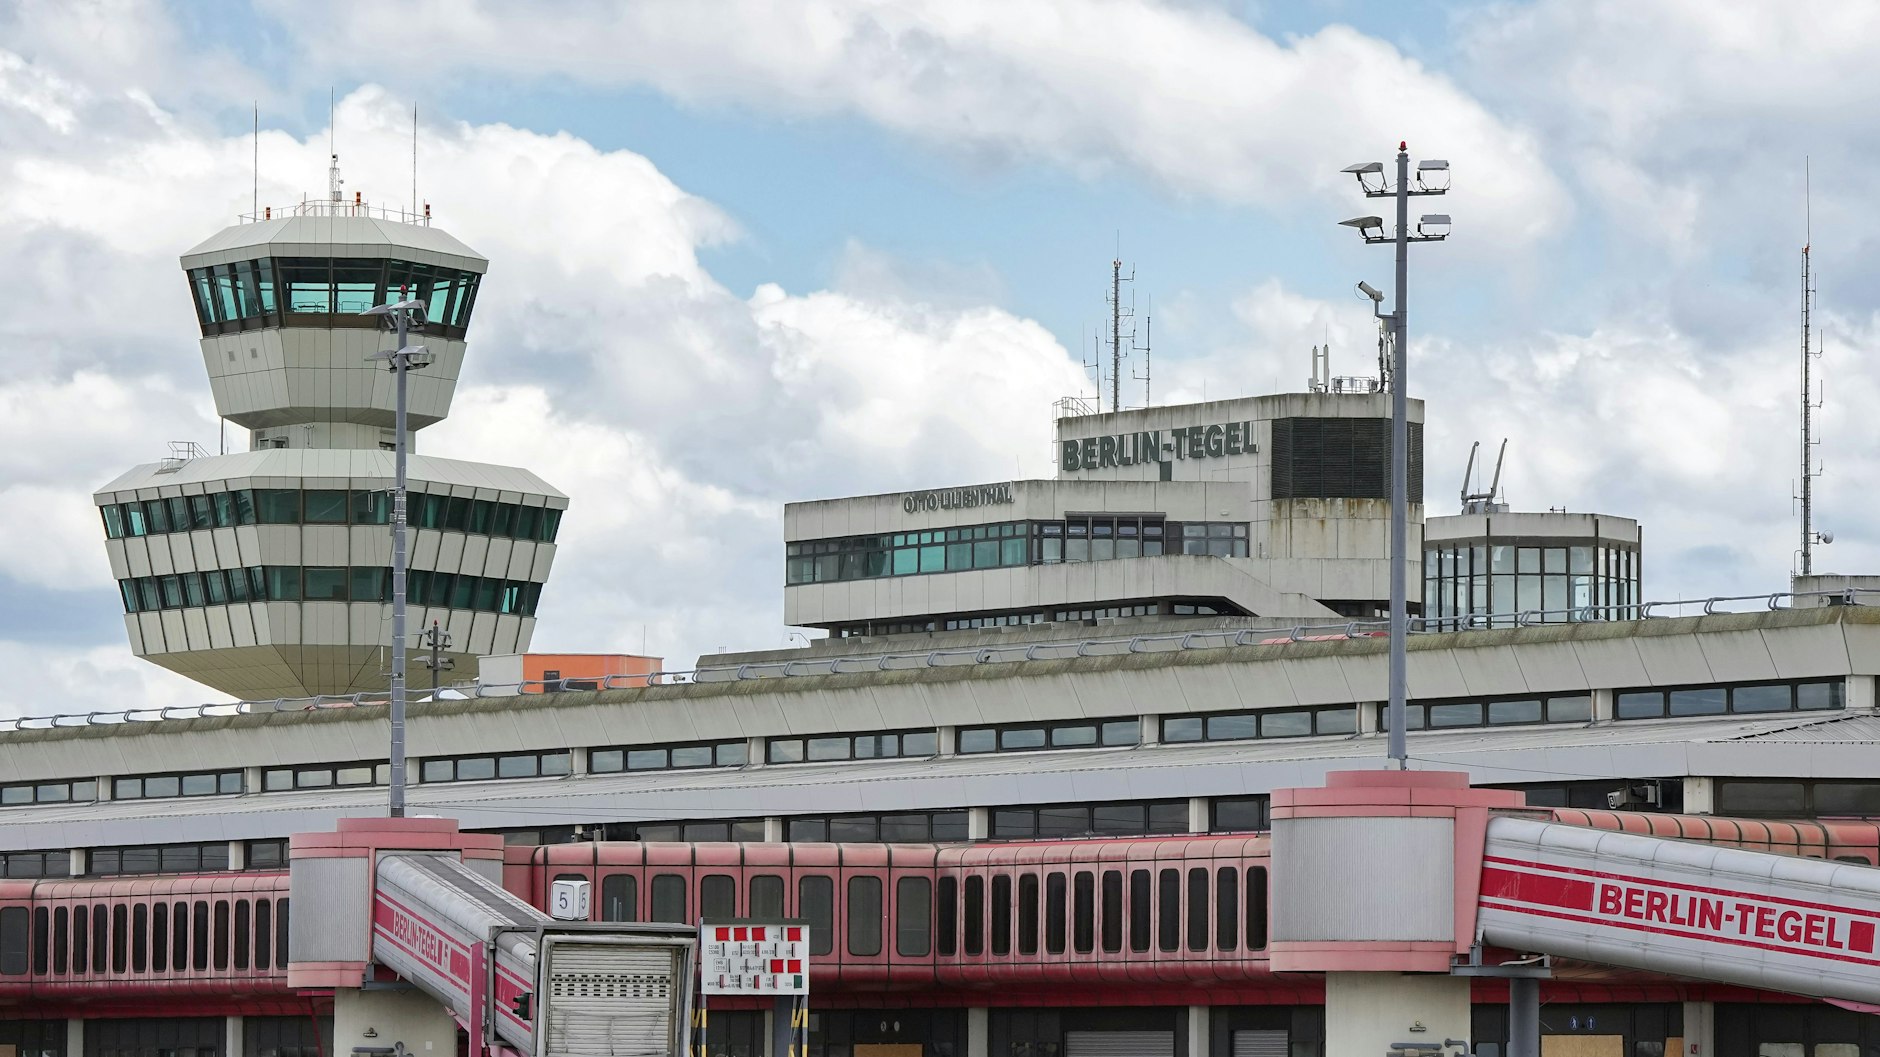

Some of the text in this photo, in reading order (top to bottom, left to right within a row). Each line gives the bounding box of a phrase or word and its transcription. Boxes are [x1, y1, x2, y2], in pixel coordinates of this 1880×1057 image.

[1063, 421, 1259, 471] BERLIN-TEGEL
[904, 484, 1015, 513] OTTO LILIENTHAL
[559, 892, 568, 909] 5
[581, 892, 587, 910] 5
[1599, 883, 1843, 949] BERLIN-TEGEL
[394, 911, 437, 963] BERLIN-TEGEL
